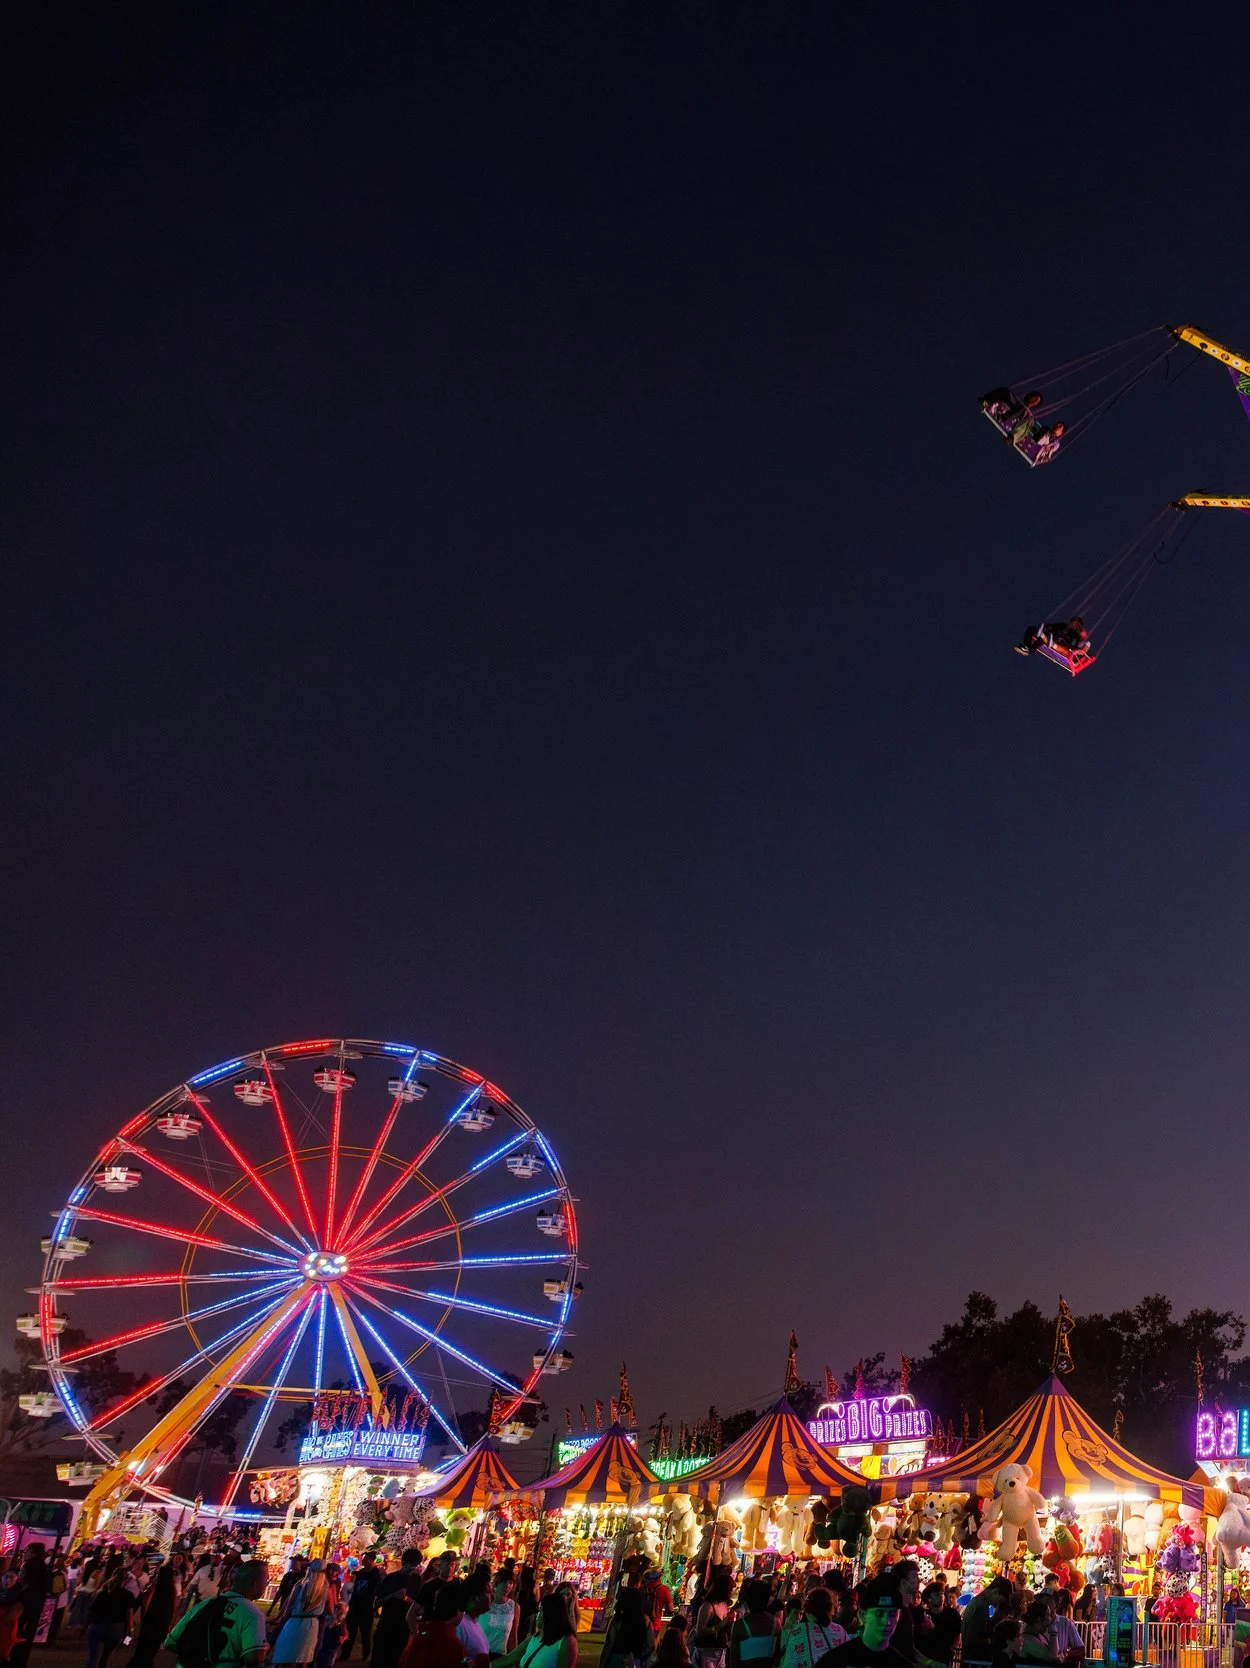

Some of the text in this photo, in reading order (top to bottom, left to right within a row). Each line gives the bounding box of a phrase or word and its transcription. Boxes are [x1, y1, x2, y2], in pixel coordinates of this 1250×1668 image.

[809, 1400, 927, 1443] PRIZES BIG PRIZES
[361, 1430, 420, 1446] WINNER
[353, 1443, 390, 1457] EVERY
[391, 1446, 420, 1460] TIME
